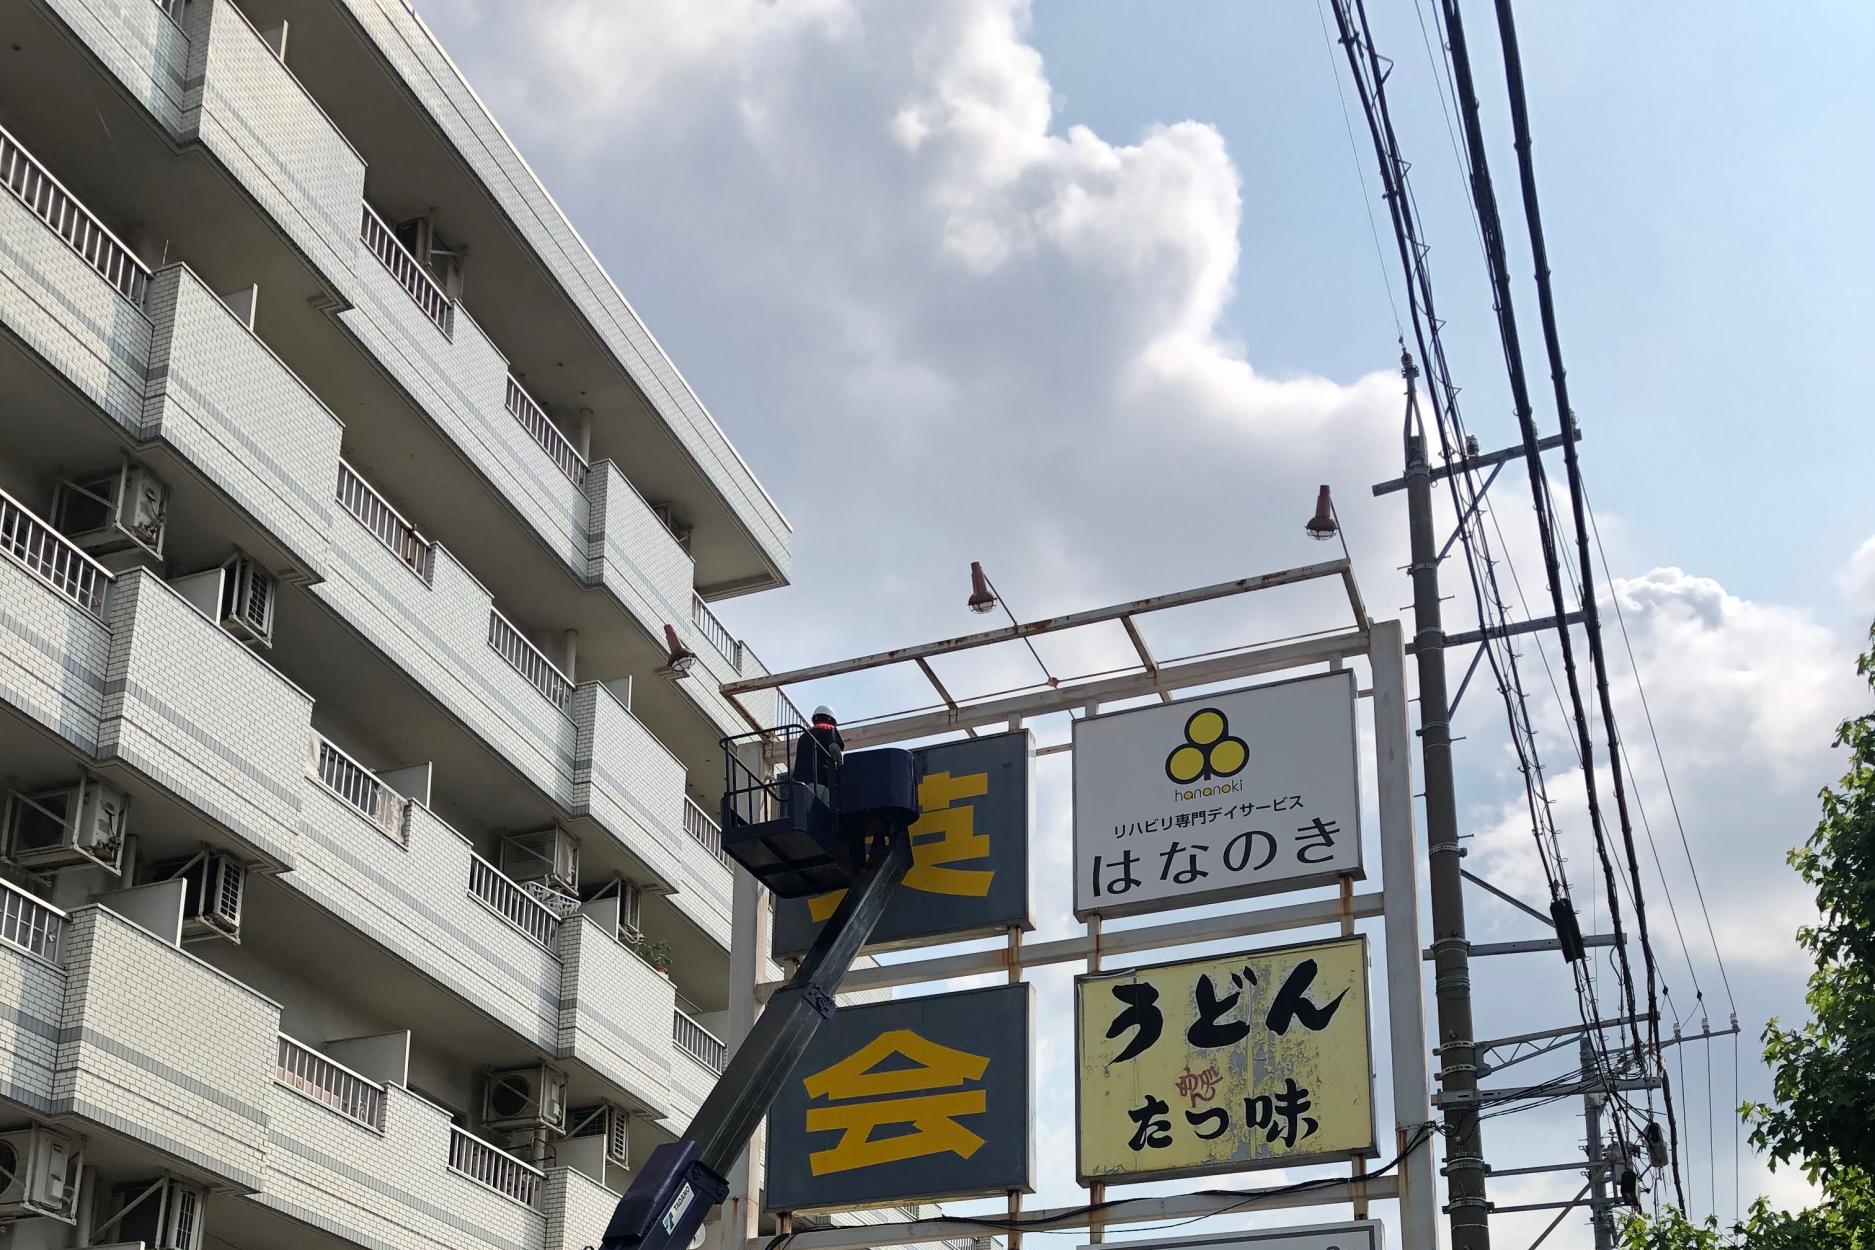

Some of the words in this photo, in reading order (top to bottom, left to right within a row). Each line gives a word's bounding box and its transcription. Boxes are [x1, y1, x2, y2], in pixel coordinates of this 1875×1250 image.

[1114, 795, 1304, 839] リハビリ専門デイサービス
[1174, 779, 1244, 802] hananoki
[1093, 817, 1341, 897] はなのき
[1105, 958, 1351, 1068] うどん
[1127, 1077, 1319, 1152] たつ味
